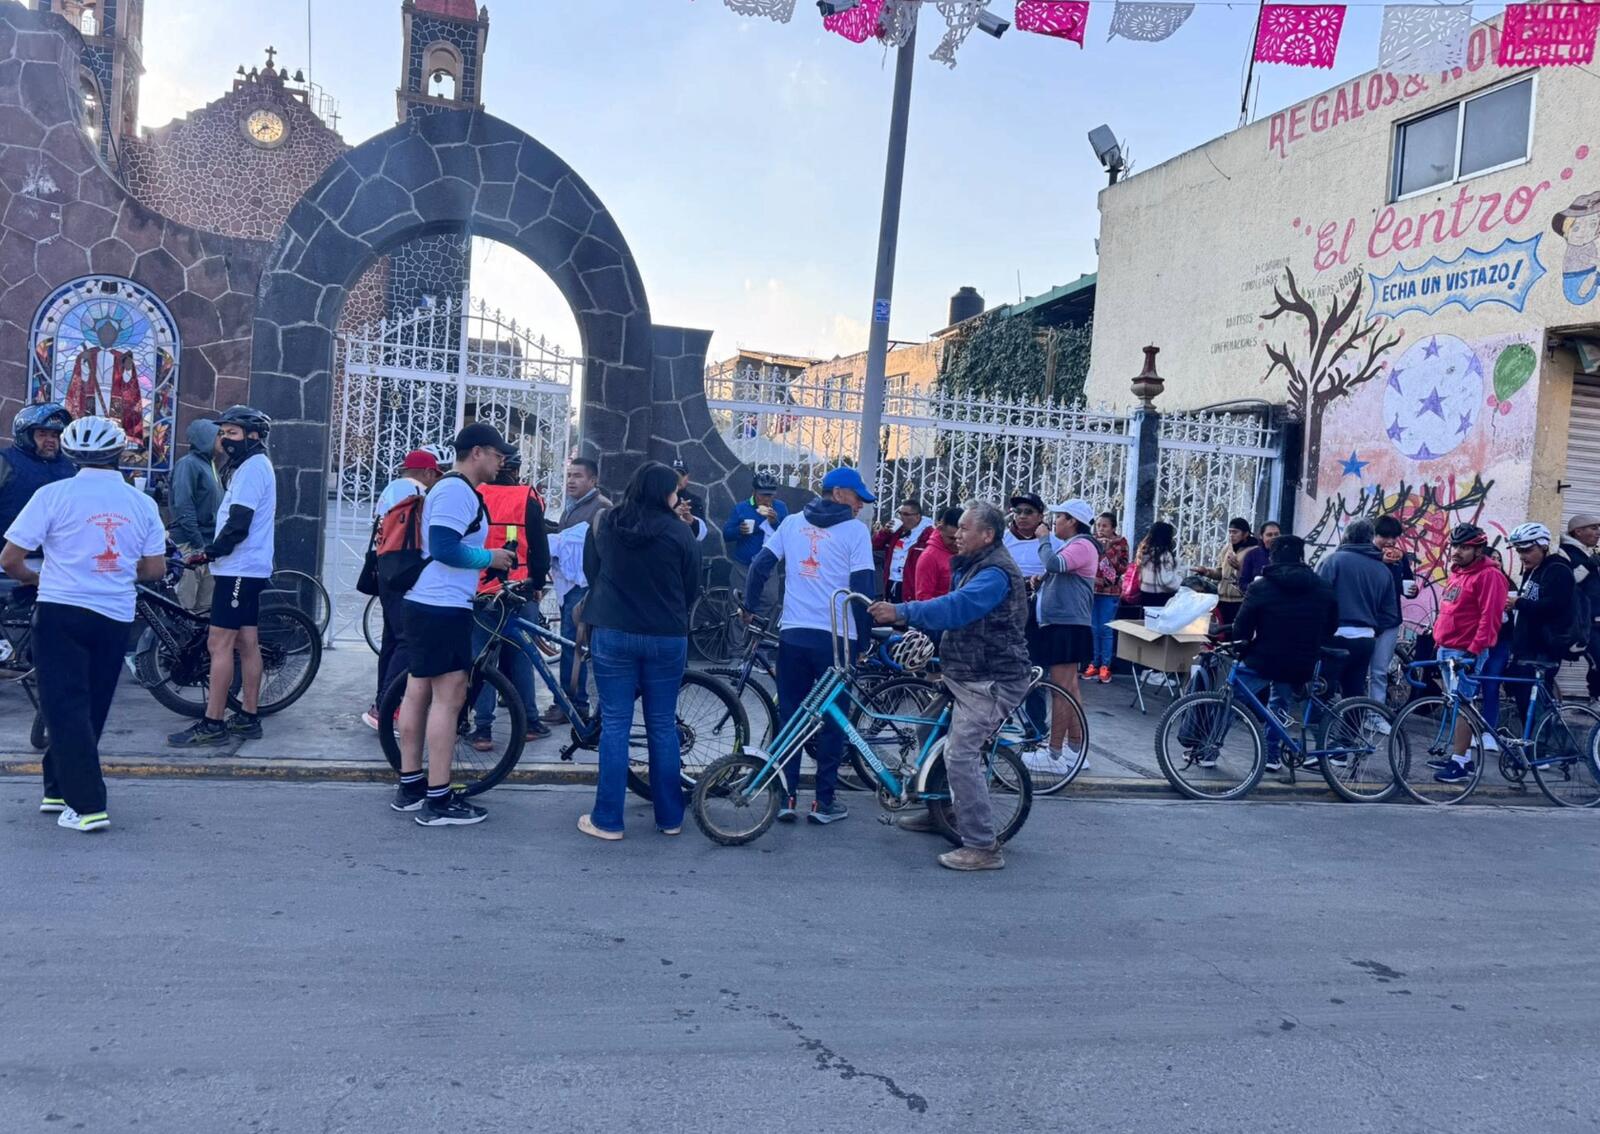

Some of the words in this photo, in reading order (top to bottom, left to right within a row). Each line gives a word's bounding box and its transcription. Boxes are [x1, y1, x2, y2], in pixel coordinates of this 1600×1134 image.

[1268, 72, 1399, 158] REGALOS
[1313, 218, 1356, 271] El
[1367, 181, 1550, 259] Centro
[1338, 263, 1365, 290] BODAS
[1382, 280, 1416, 302] ECHA
[1421, 275, 1441, 295] UN
[1446, 259, 1524, 291] VISTAZO!
